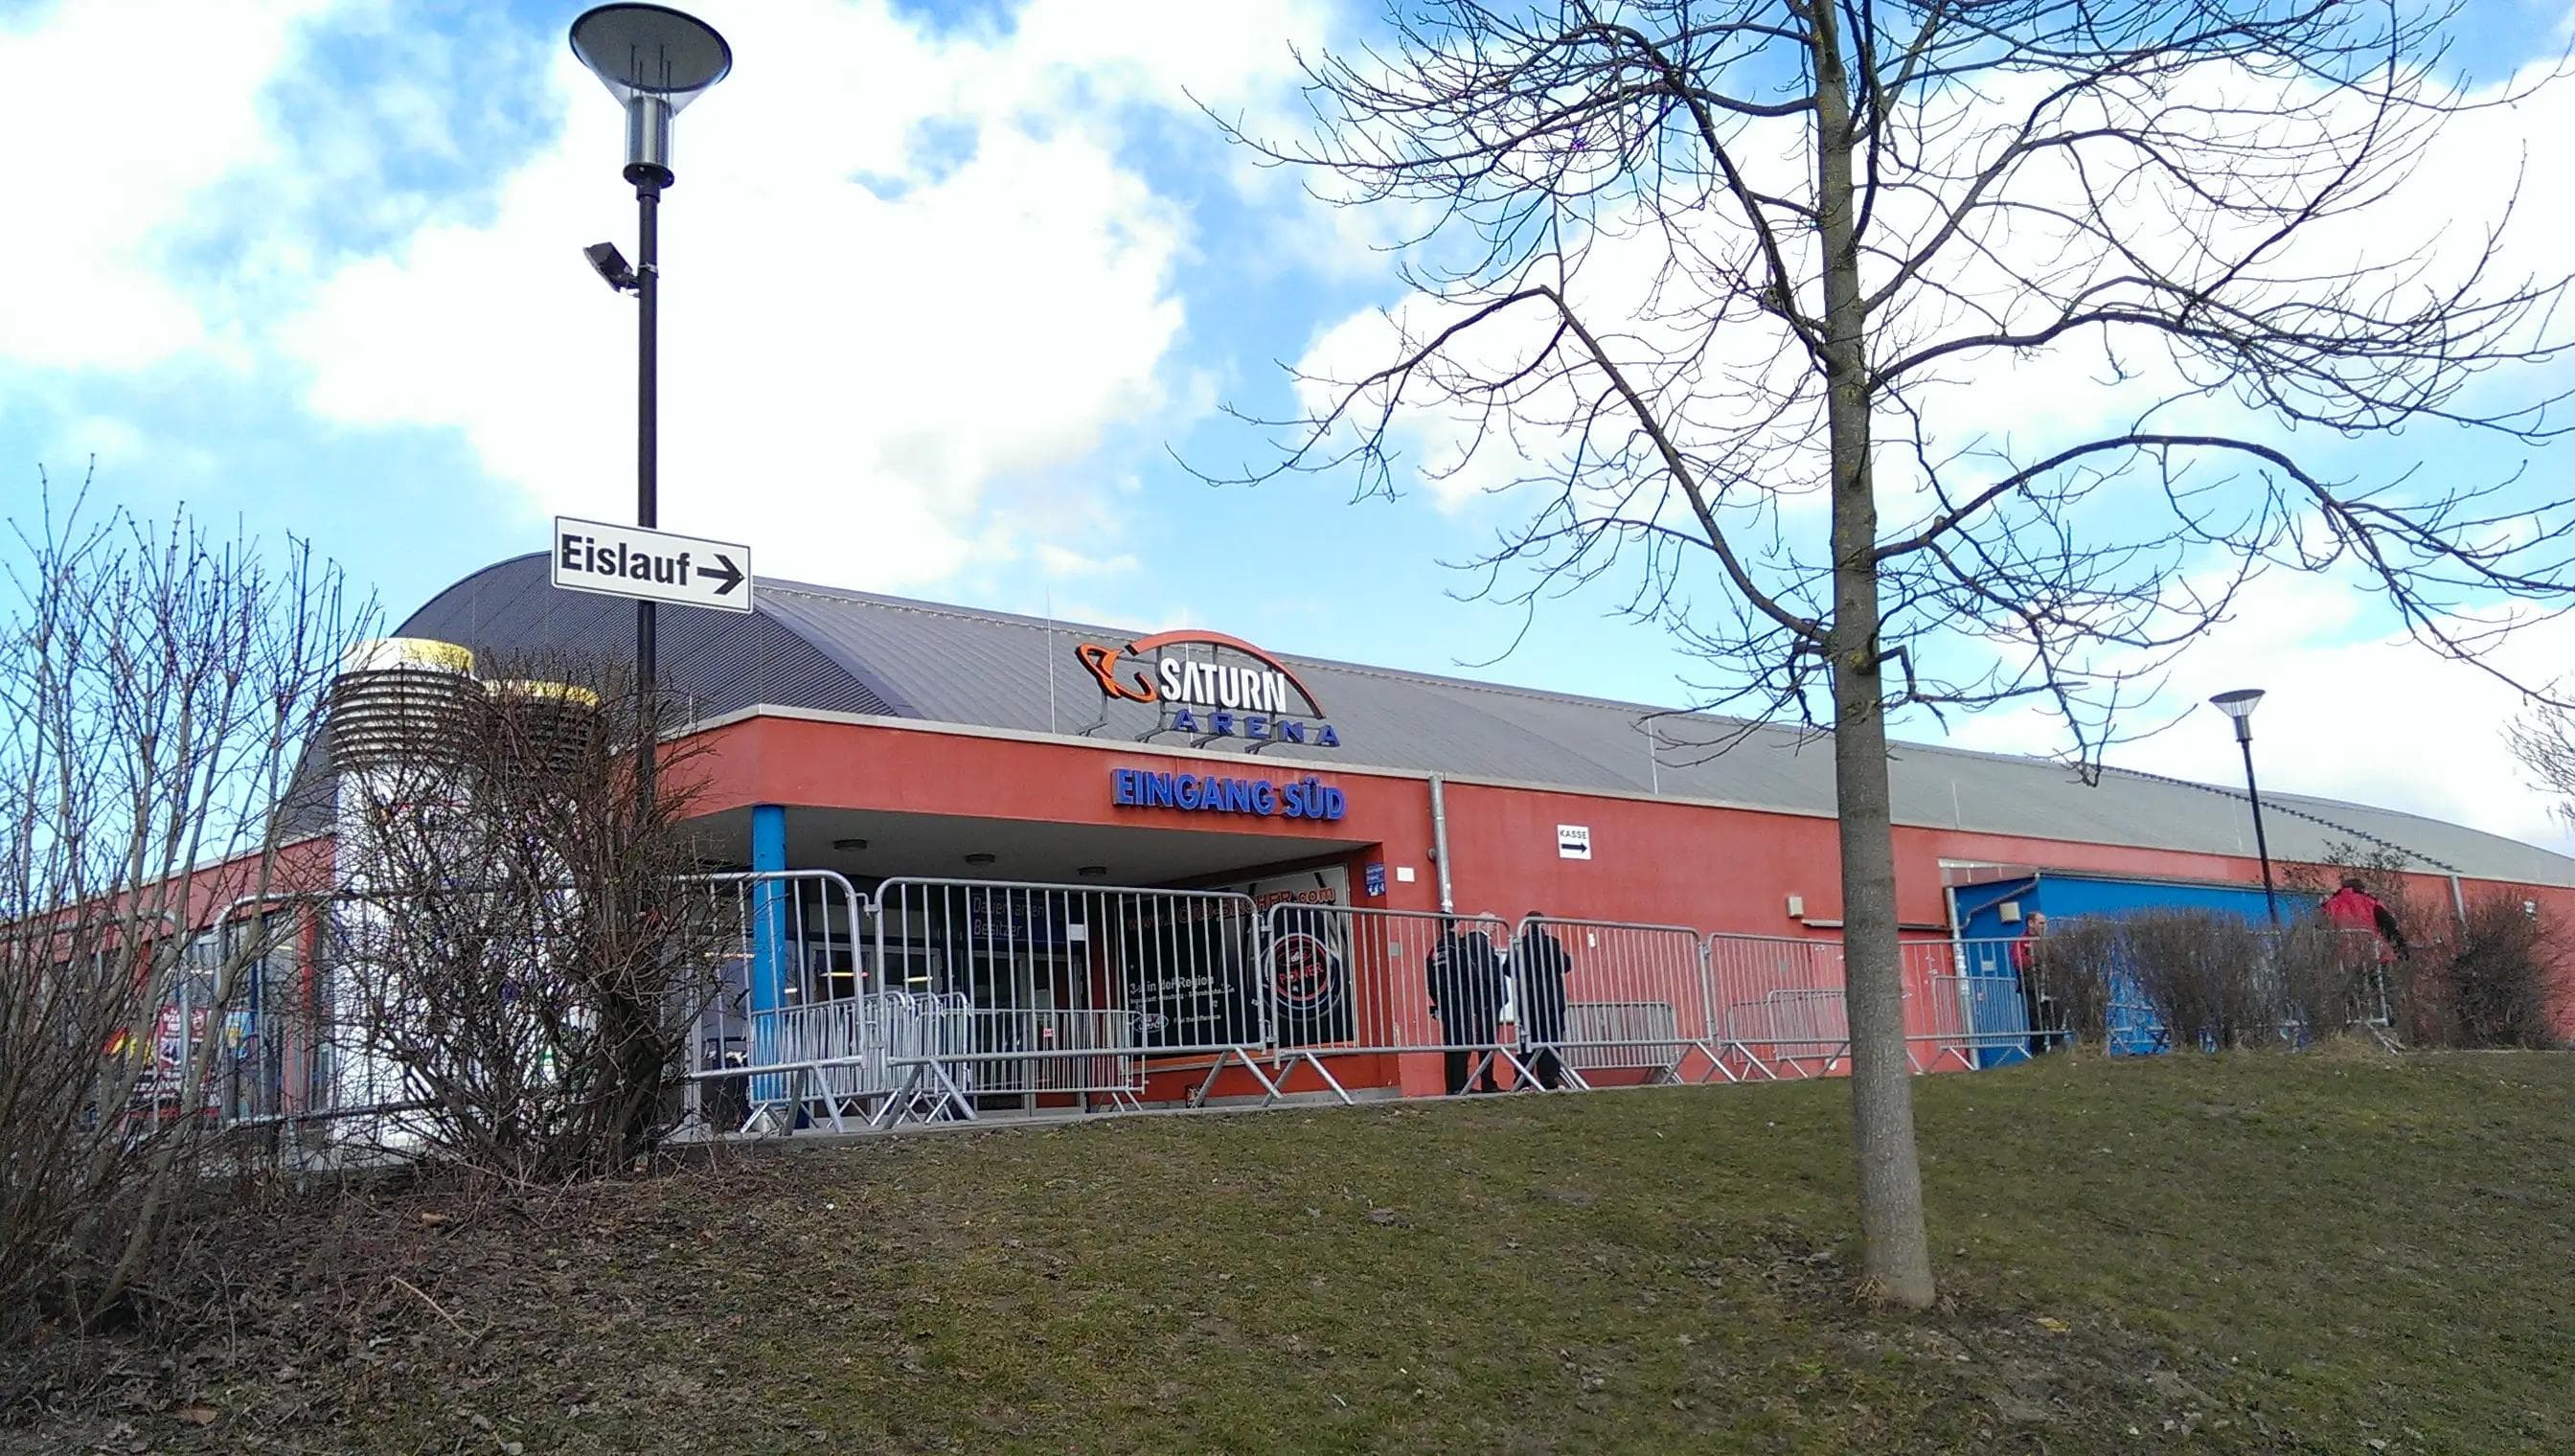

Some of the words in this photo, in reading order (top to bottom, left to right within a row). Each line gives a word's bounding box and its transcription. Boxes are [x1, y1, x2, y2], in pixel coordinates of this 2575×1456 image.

[561, 534, 691, 586] Eislauf
[1159, 658, 1288, 714] SATURN
[1172, 710, 1341, 747] ARENA
[1114, 769, 1275, 815] EINGANG
[1284, 778, 1347, 819] SÜD
[1560, 830, 1587, 840] KASSE
[1178, 973, 1215, 990] Reion
